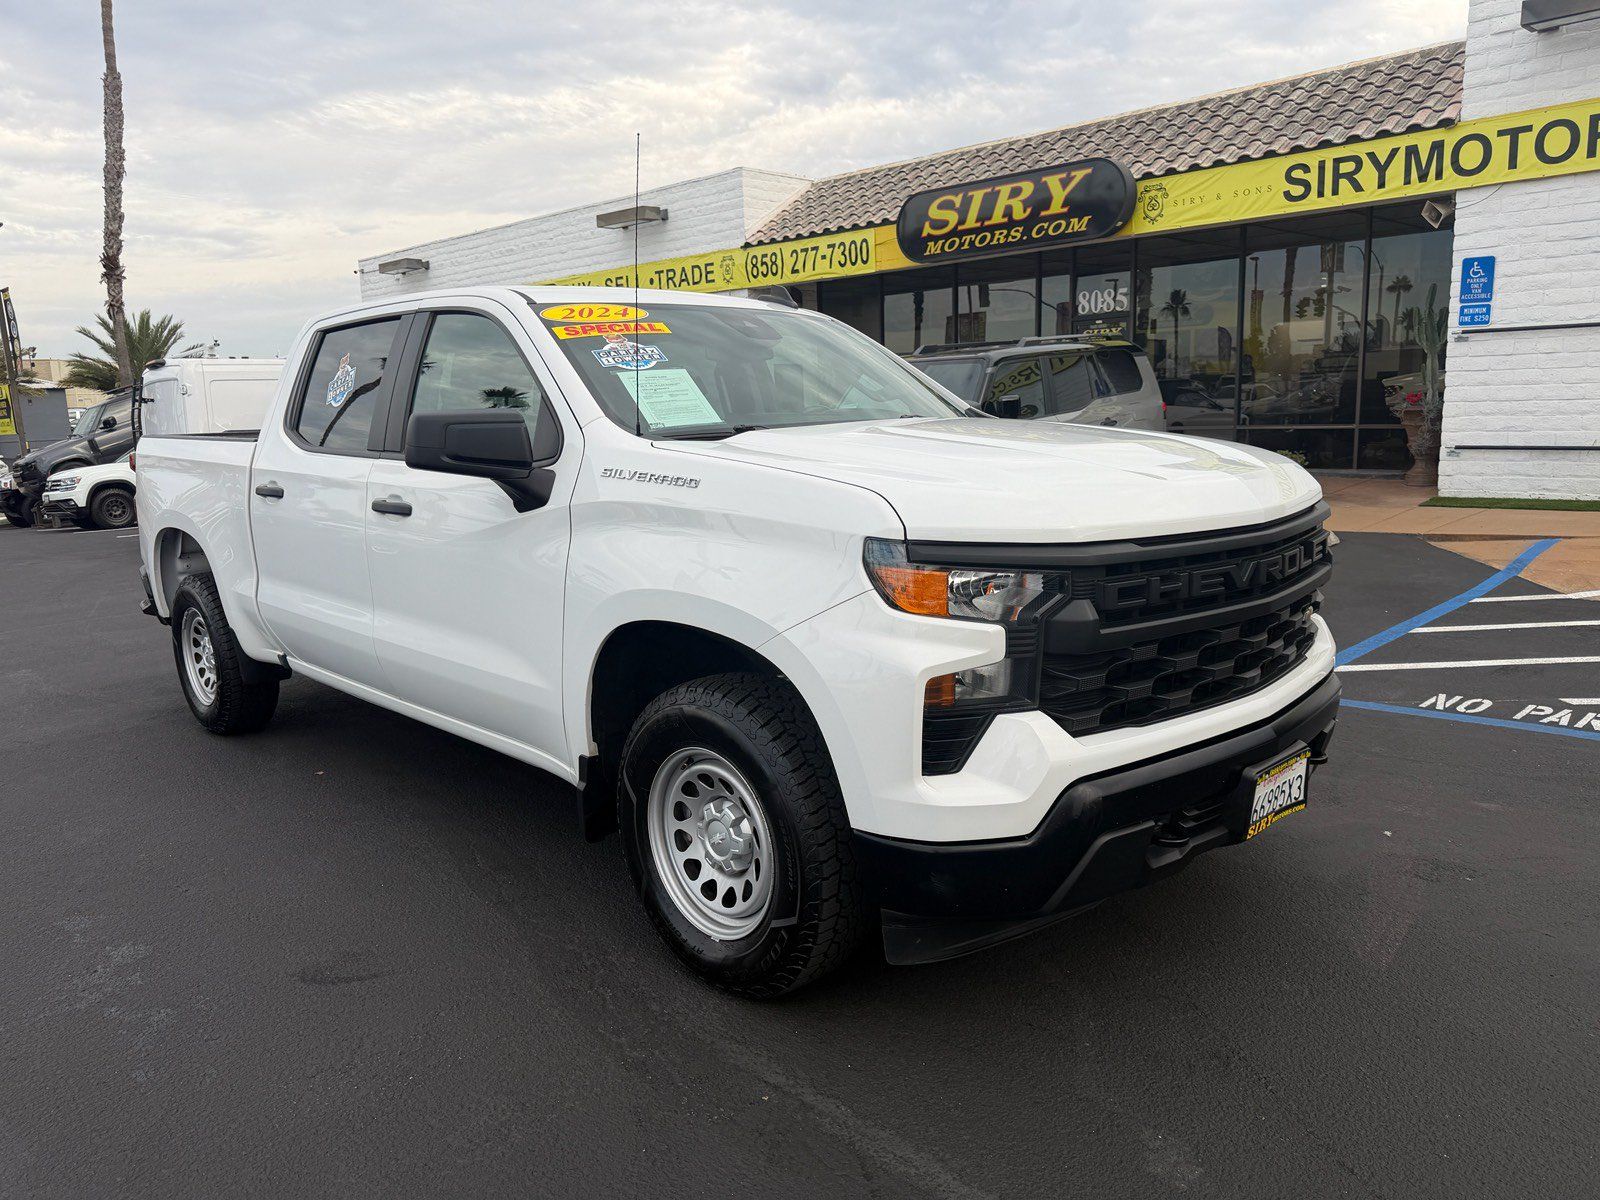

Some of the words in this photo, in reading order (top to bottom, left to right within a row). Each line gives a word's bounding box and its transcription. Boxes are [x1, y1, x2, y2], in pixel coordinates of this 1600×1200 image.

[921, 168, 1093, 239] SIRY
[1172, 195, 1206, 207] SIRY
[1215, 192, 1222, 201] &
[1233, 184, 1273, 199] SONS
[923, 215, 1093, 256] MOTORS.COM
[745, 247, 784, 283] (858)
[790, 238, 870, 275] 277-7300
[1078, 287, 1128, 315] 8085
[1463, 307, 1487, 315] MINIMUM
[561, 306, 630, 320] 2024
[563, 322, 664, 337] SPECIAL
[599, 346, 658, 358] CARFAX
[600, 468, 701, 489] SILVERADO
[1418, 693, 1493, 714] NO
[1250, 773, 1304, 824] 66985X3
[1246, 812, 1275, 840] SIRY
